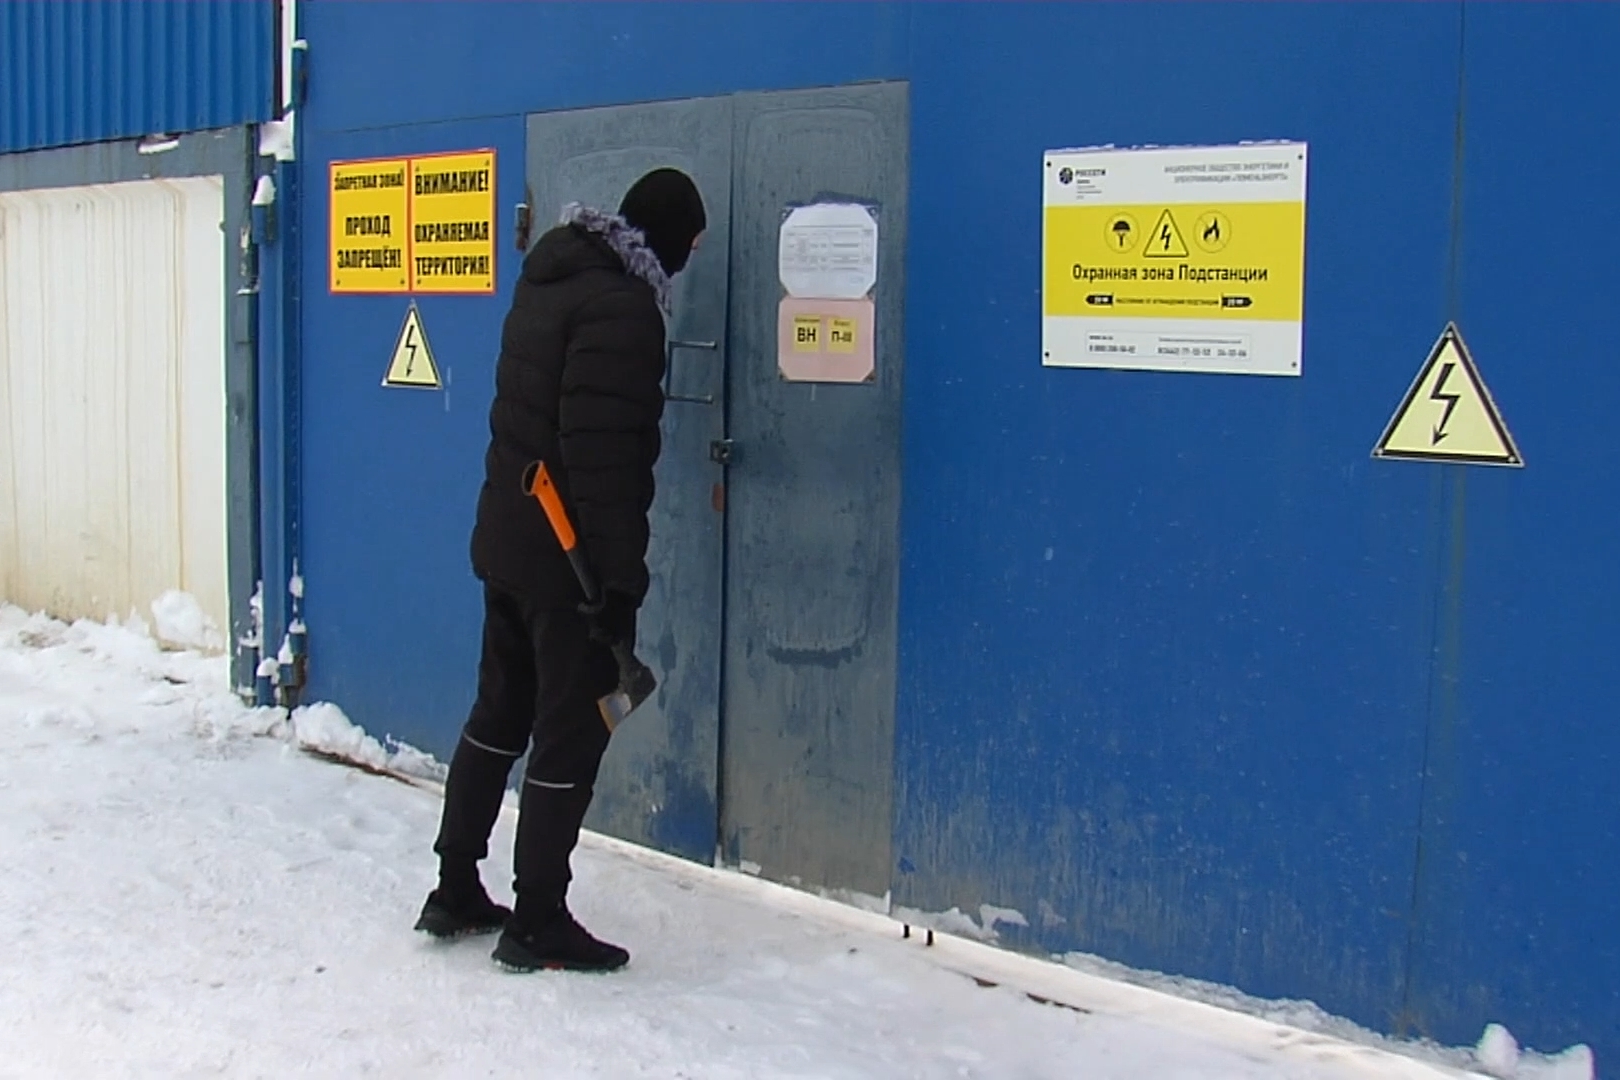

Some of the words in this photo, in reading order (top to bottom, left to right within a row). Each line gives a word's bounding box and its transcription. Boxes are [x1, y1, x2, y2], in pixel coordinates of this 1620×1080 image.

[335, 174, 377, 190] ЗАПРЕТНАЯ
[415, 169, 489, 195] ВНИМАНИЕ!
[345, 215, 391, 238] ПРОХОД
[415, 221, 489, 243] ОХРАНЯЕМАЯ
[337, 245, 402, 271] ЗАПРЕЩЁН!
[415, 255, 490, 276] ТЕРРИТОРИЯ!
[1073, 264, 1137, 283] Охранная
[1141, 268, 1175, 280] зона
[1179, 264, 1268, 283] Подстанции
[797, 327, 816, 342] ВН
